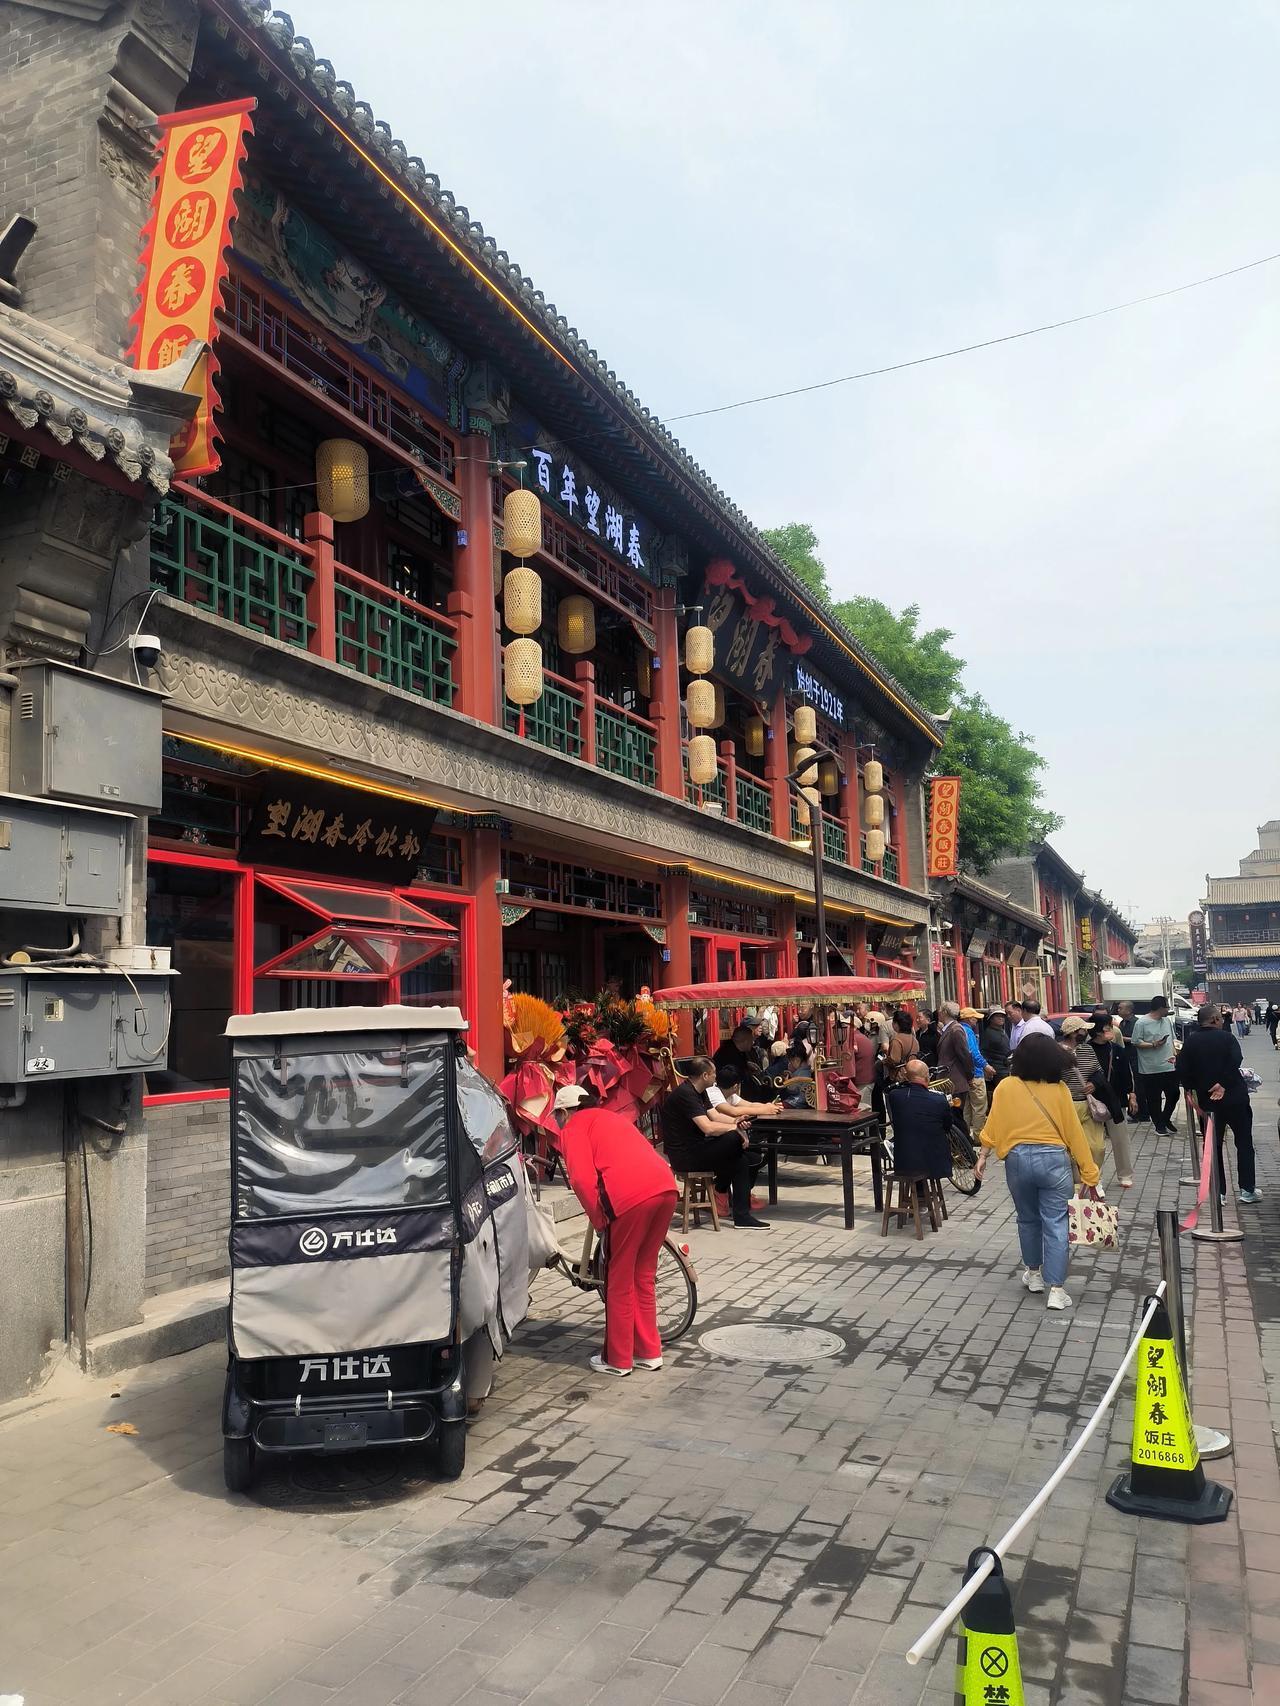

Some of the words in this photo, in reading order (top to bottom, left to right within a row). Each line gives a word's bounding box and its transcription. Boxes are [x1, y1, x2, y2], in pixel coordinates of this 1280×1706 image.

[532, 449, 645, 568] 百年望湖春
[797, 664, 844, 723] 始创于1921年
[332, 1227, 397, 1249] 万仕达
[299, 1354, 392, 1383] 万仕达
[1146, 1346, 1169, 1425] 望湖春
[1144, 1429, 1176, 1447] 饭庄
[1138, 1448, 1185, 1464] 2016868
